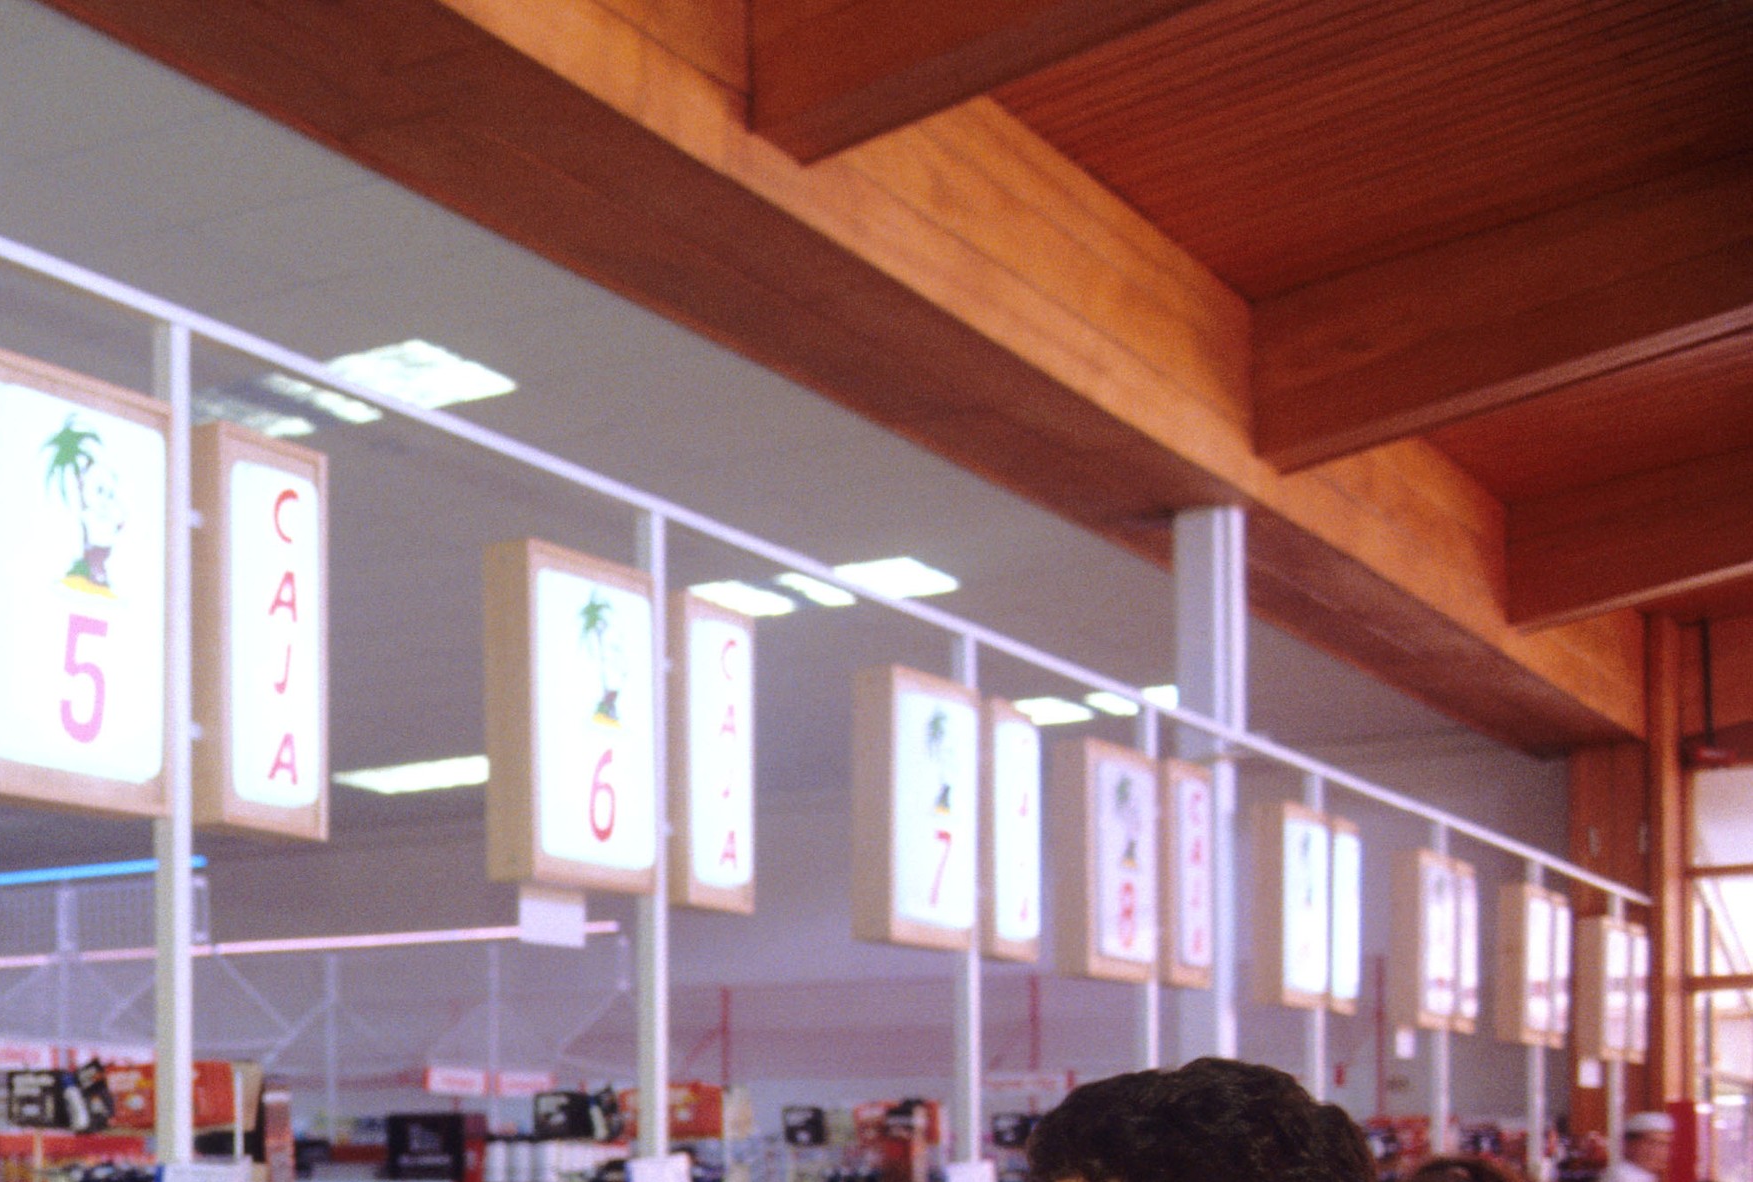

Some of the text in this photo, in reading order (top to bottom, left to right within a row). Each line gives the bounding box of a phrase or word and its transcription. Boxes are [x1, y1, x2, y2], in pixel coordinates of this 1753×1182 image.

[59, 613, 109, 744] 5
[268, 489, 300, 787] CAJA
[589, 748, 617, 842] 6
[929, 829, 952, 908] 7
